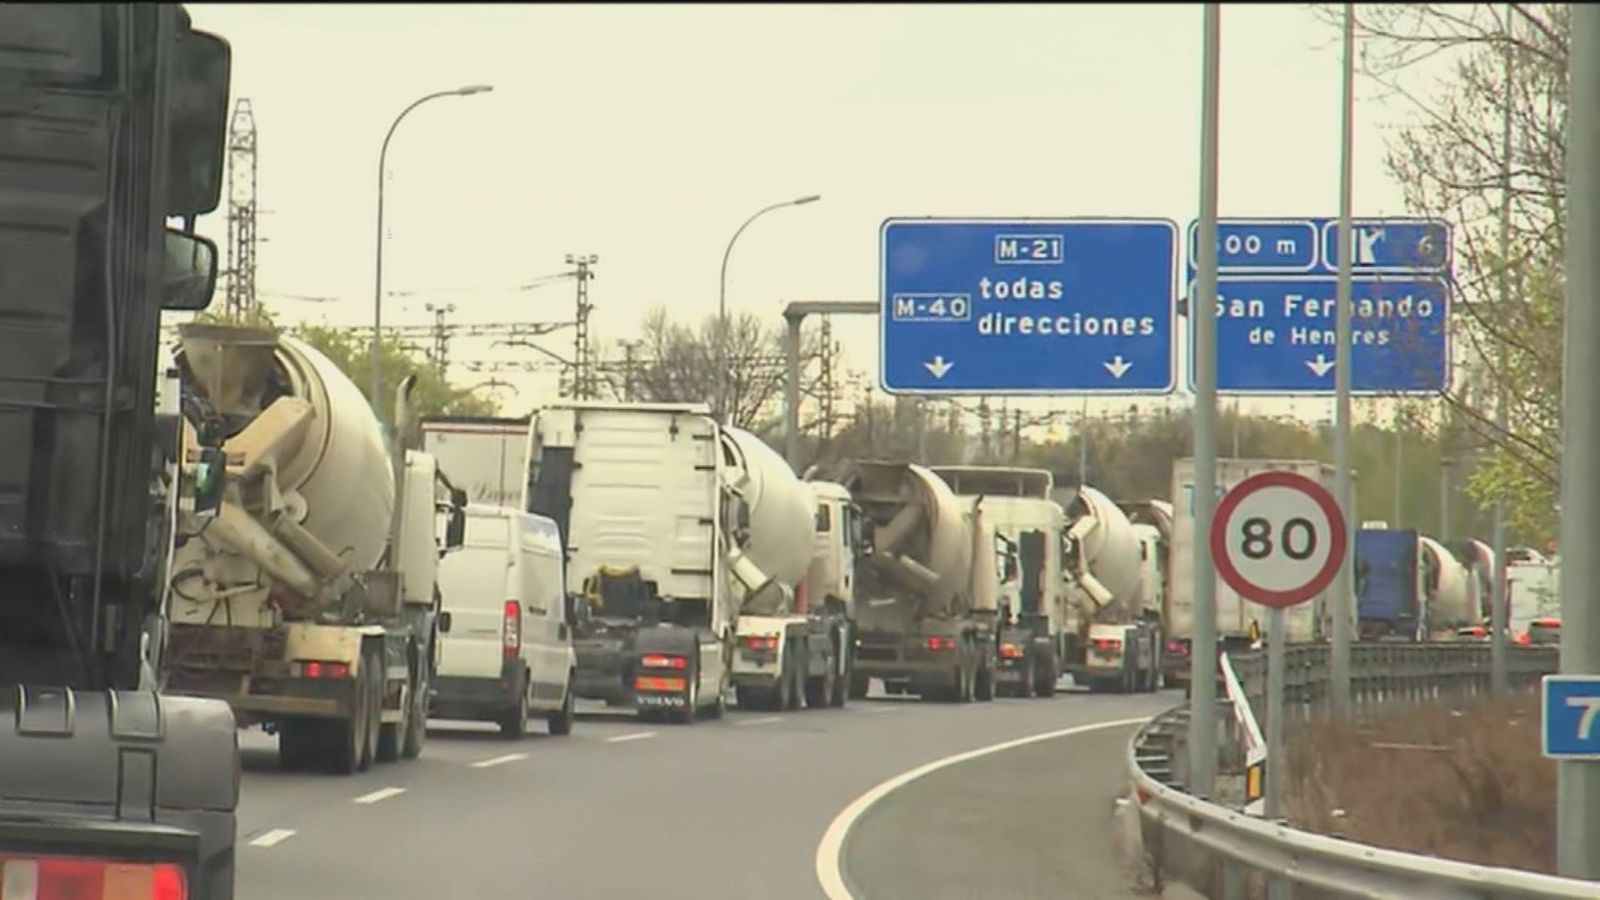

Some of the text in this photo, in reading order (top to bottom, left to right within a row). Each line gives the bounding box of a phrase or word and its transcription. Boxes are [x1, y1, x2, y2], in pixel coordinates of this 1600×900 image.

[999, 240, 1060, 258] M-21
[1216, 234, 1296, 254] 00 m
[979, 276, 1064, 299] todas
[897, 298, 968, 317] M-40
[978, 313, 1154, 335] direcciones
[1249, 327, 1390, 345] de Henres
[1241, 517, 1317, 560] 80
